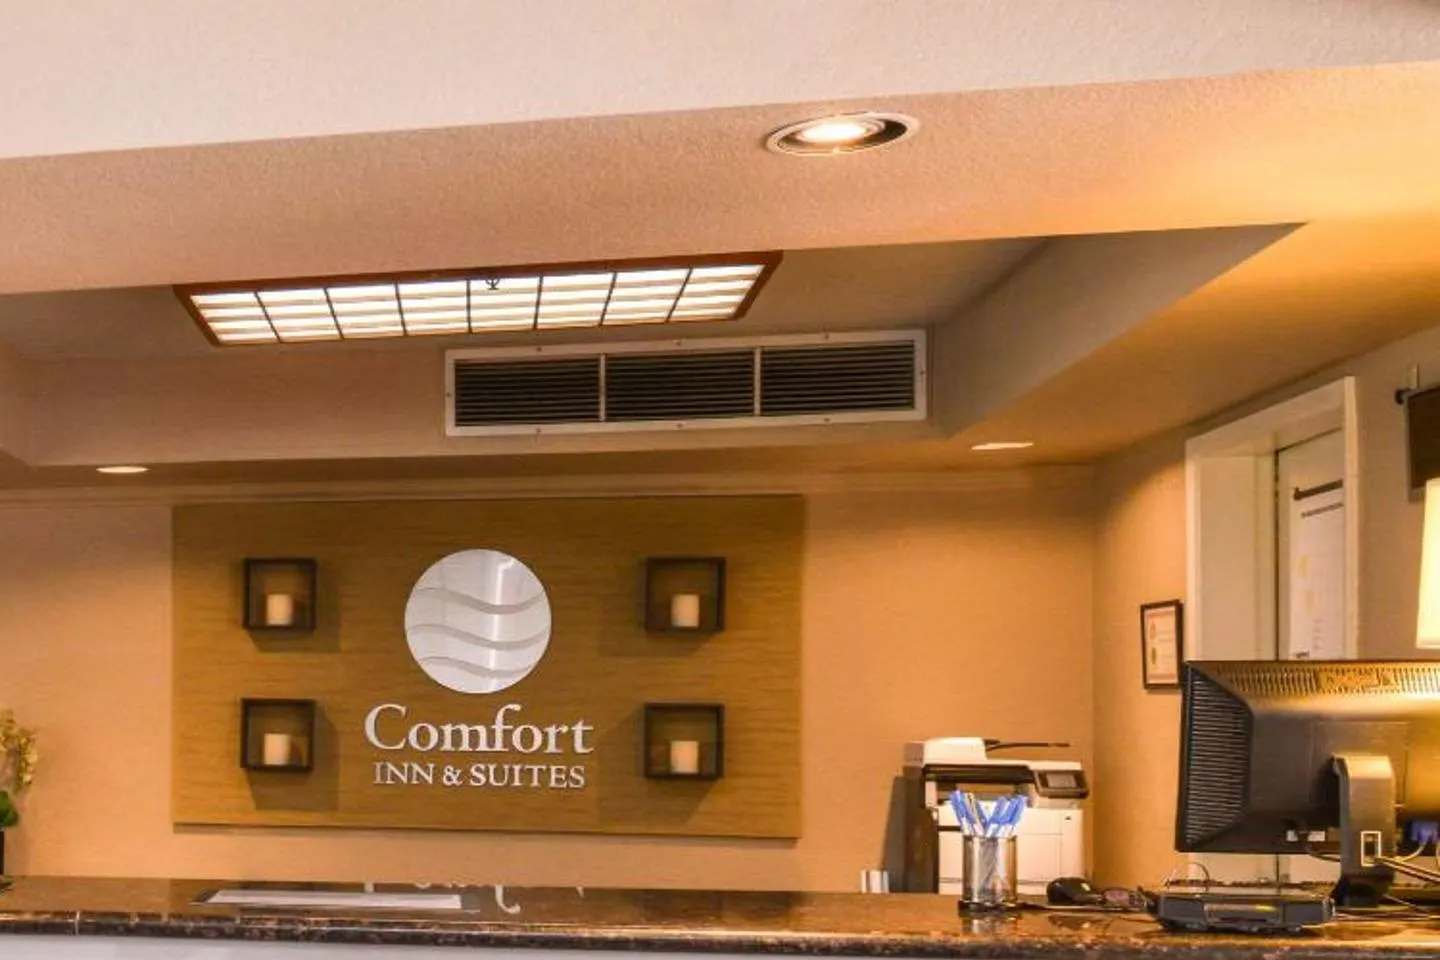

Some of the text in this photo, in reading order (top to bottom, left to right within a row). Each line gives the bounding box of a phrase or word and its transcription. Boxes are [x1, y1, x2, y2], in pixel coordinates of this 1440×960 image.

[364, 703, 594, 754] Comfort
[373, 762, 586, 788] INN & SUITES
